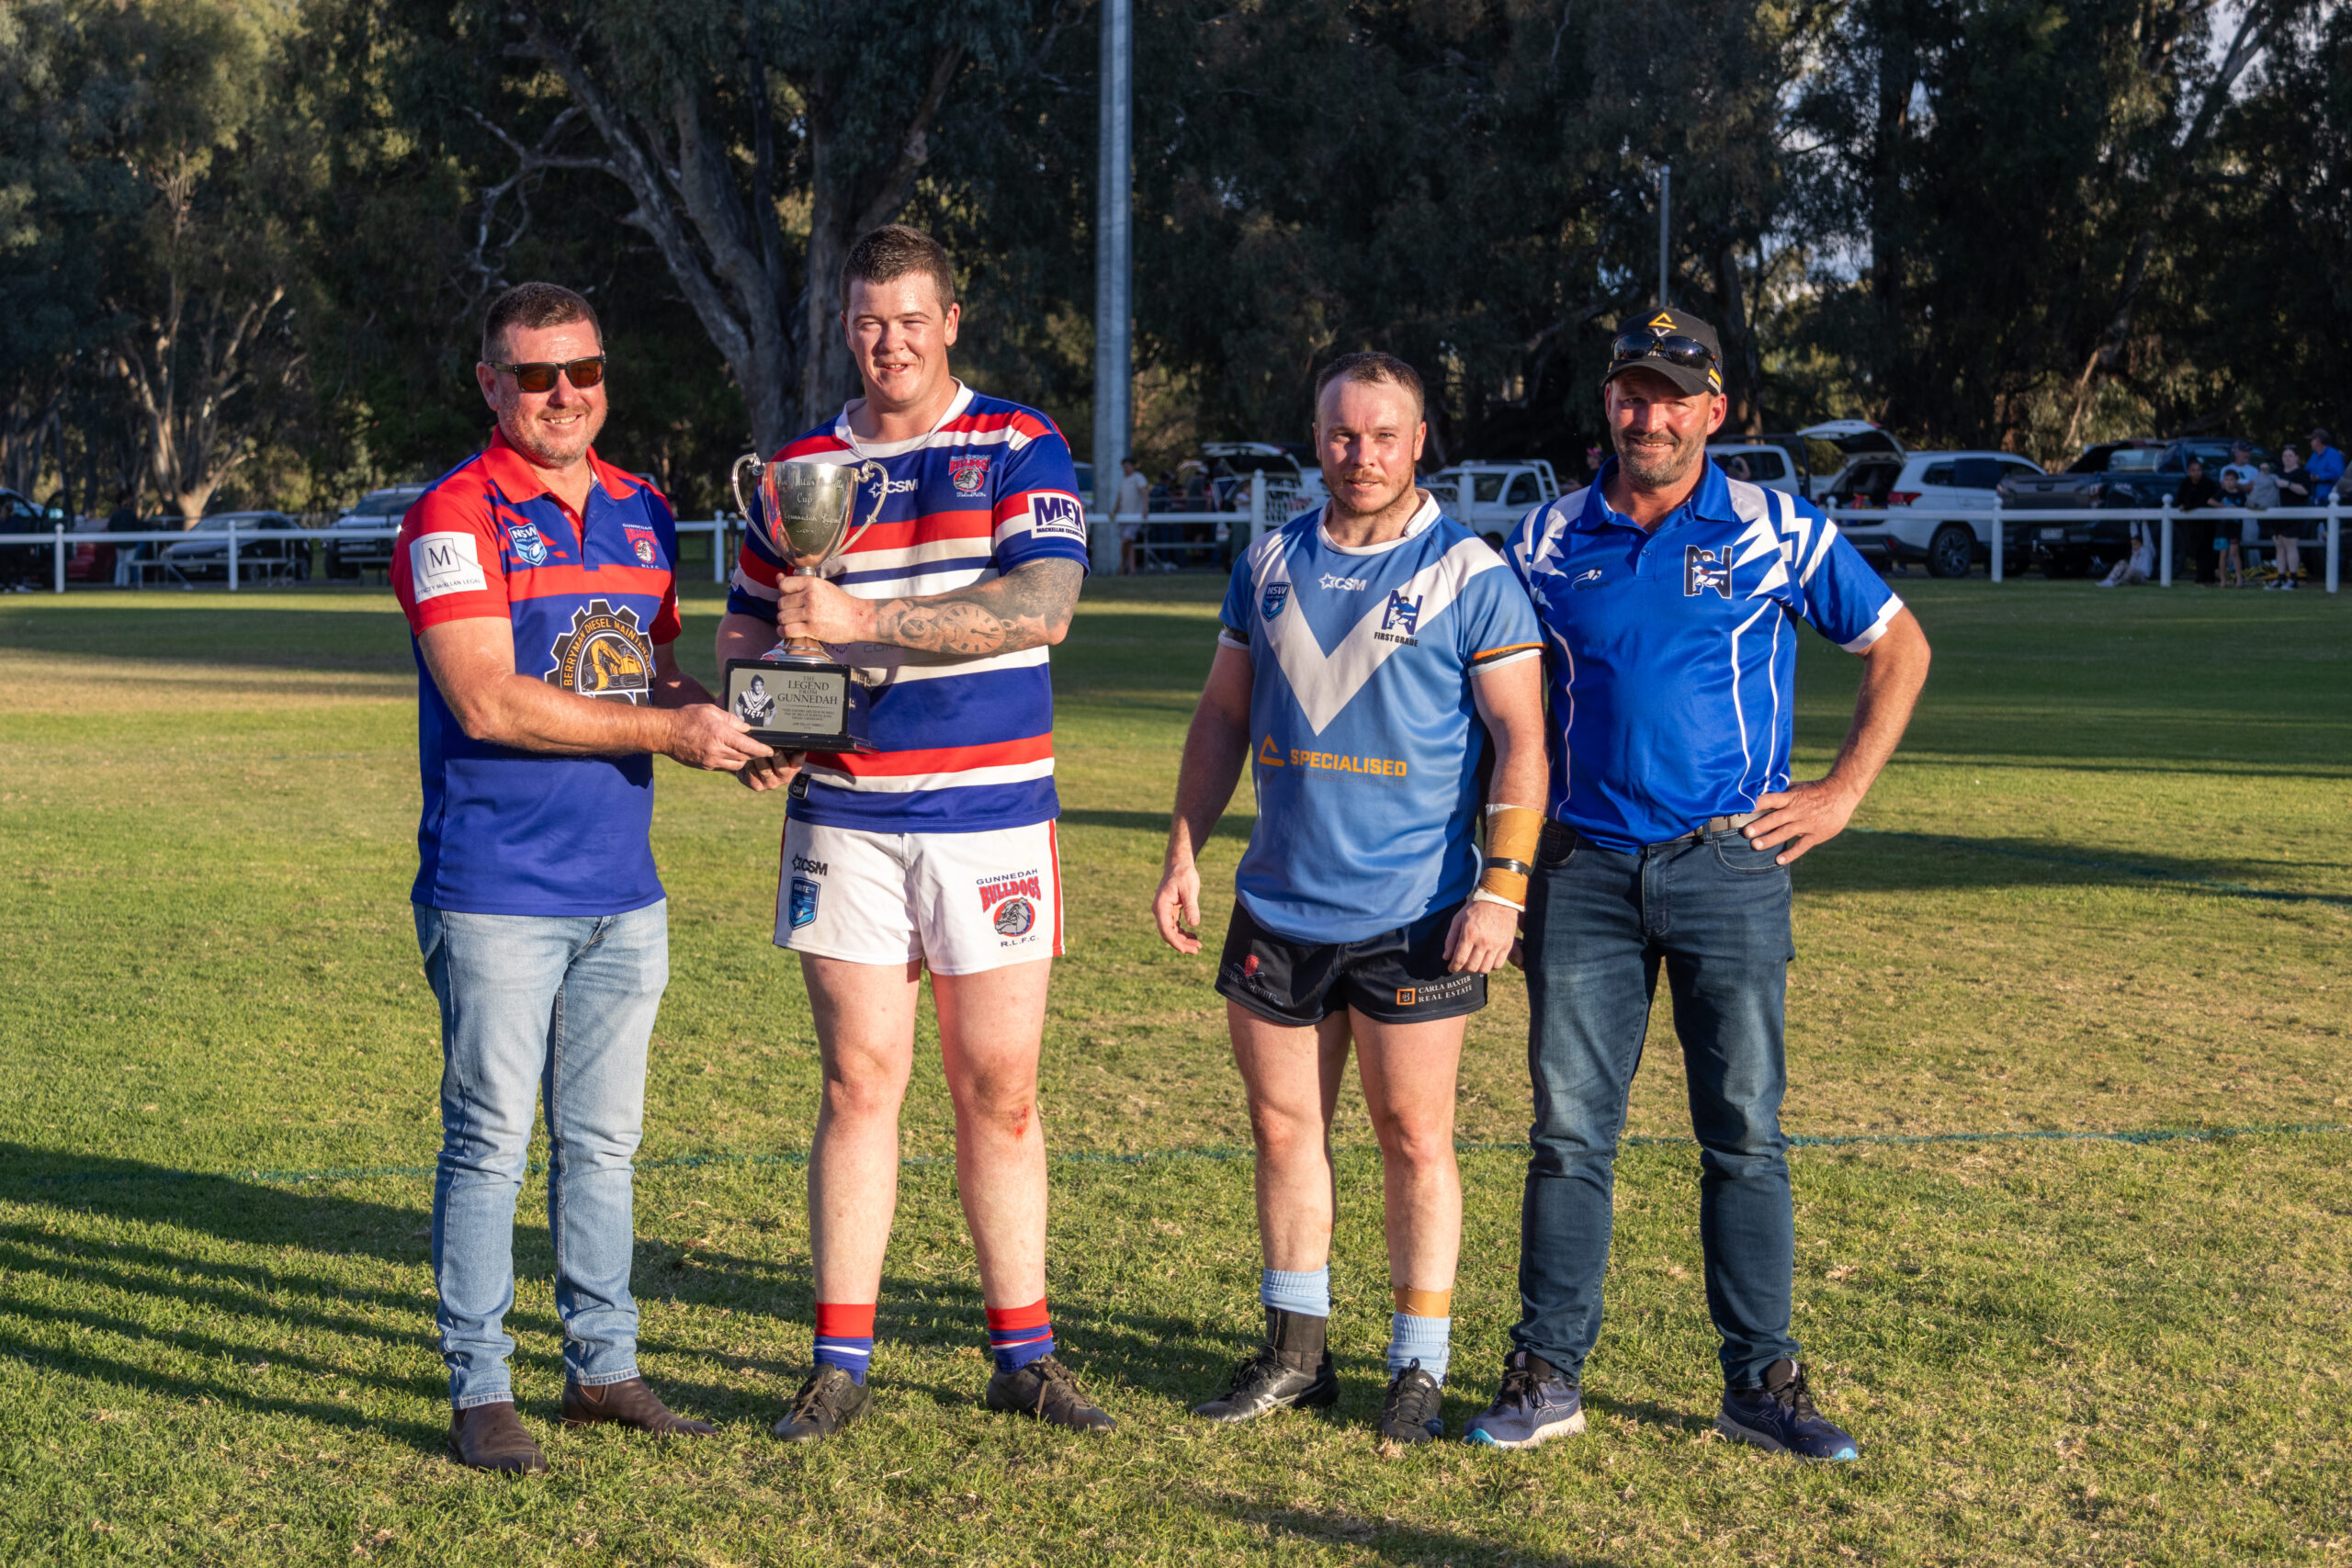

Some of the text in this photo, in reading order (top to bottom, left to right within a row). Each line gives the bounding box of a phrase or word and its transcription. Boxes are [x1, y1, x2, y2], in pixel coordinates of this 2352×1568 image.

[797, 491, 813, 506] Cup
[1034, 497, 1084, 535] MEX
[512, 526, 538, 538] NSW
[428, 545, 451, 569] M
[1267, 586, 1288, 595] NSW
[1334, 577, 1367, 592] CSM
[1374, 631, 1419, 648] FIRST GRADE
[563, 631, 585, 686] BERRYMAN
[584, 617, 612, 634] DIESEL
[788, 680, 830, 691] LEGEND
[777, 694, 838, 705] GUNNEDAH
[1290, 749, 1408, 777] SPECIALISED
[801, 858, 829, 876] CSM
[976, 868, 1038, 885] GUNNEDAH
[978, 875, 1042, 913] BULLDOGS
[1418, 975, 1472, 994] CARLA BAXTER
[1418, 984, 1473, 1003] REAL ESTATE
